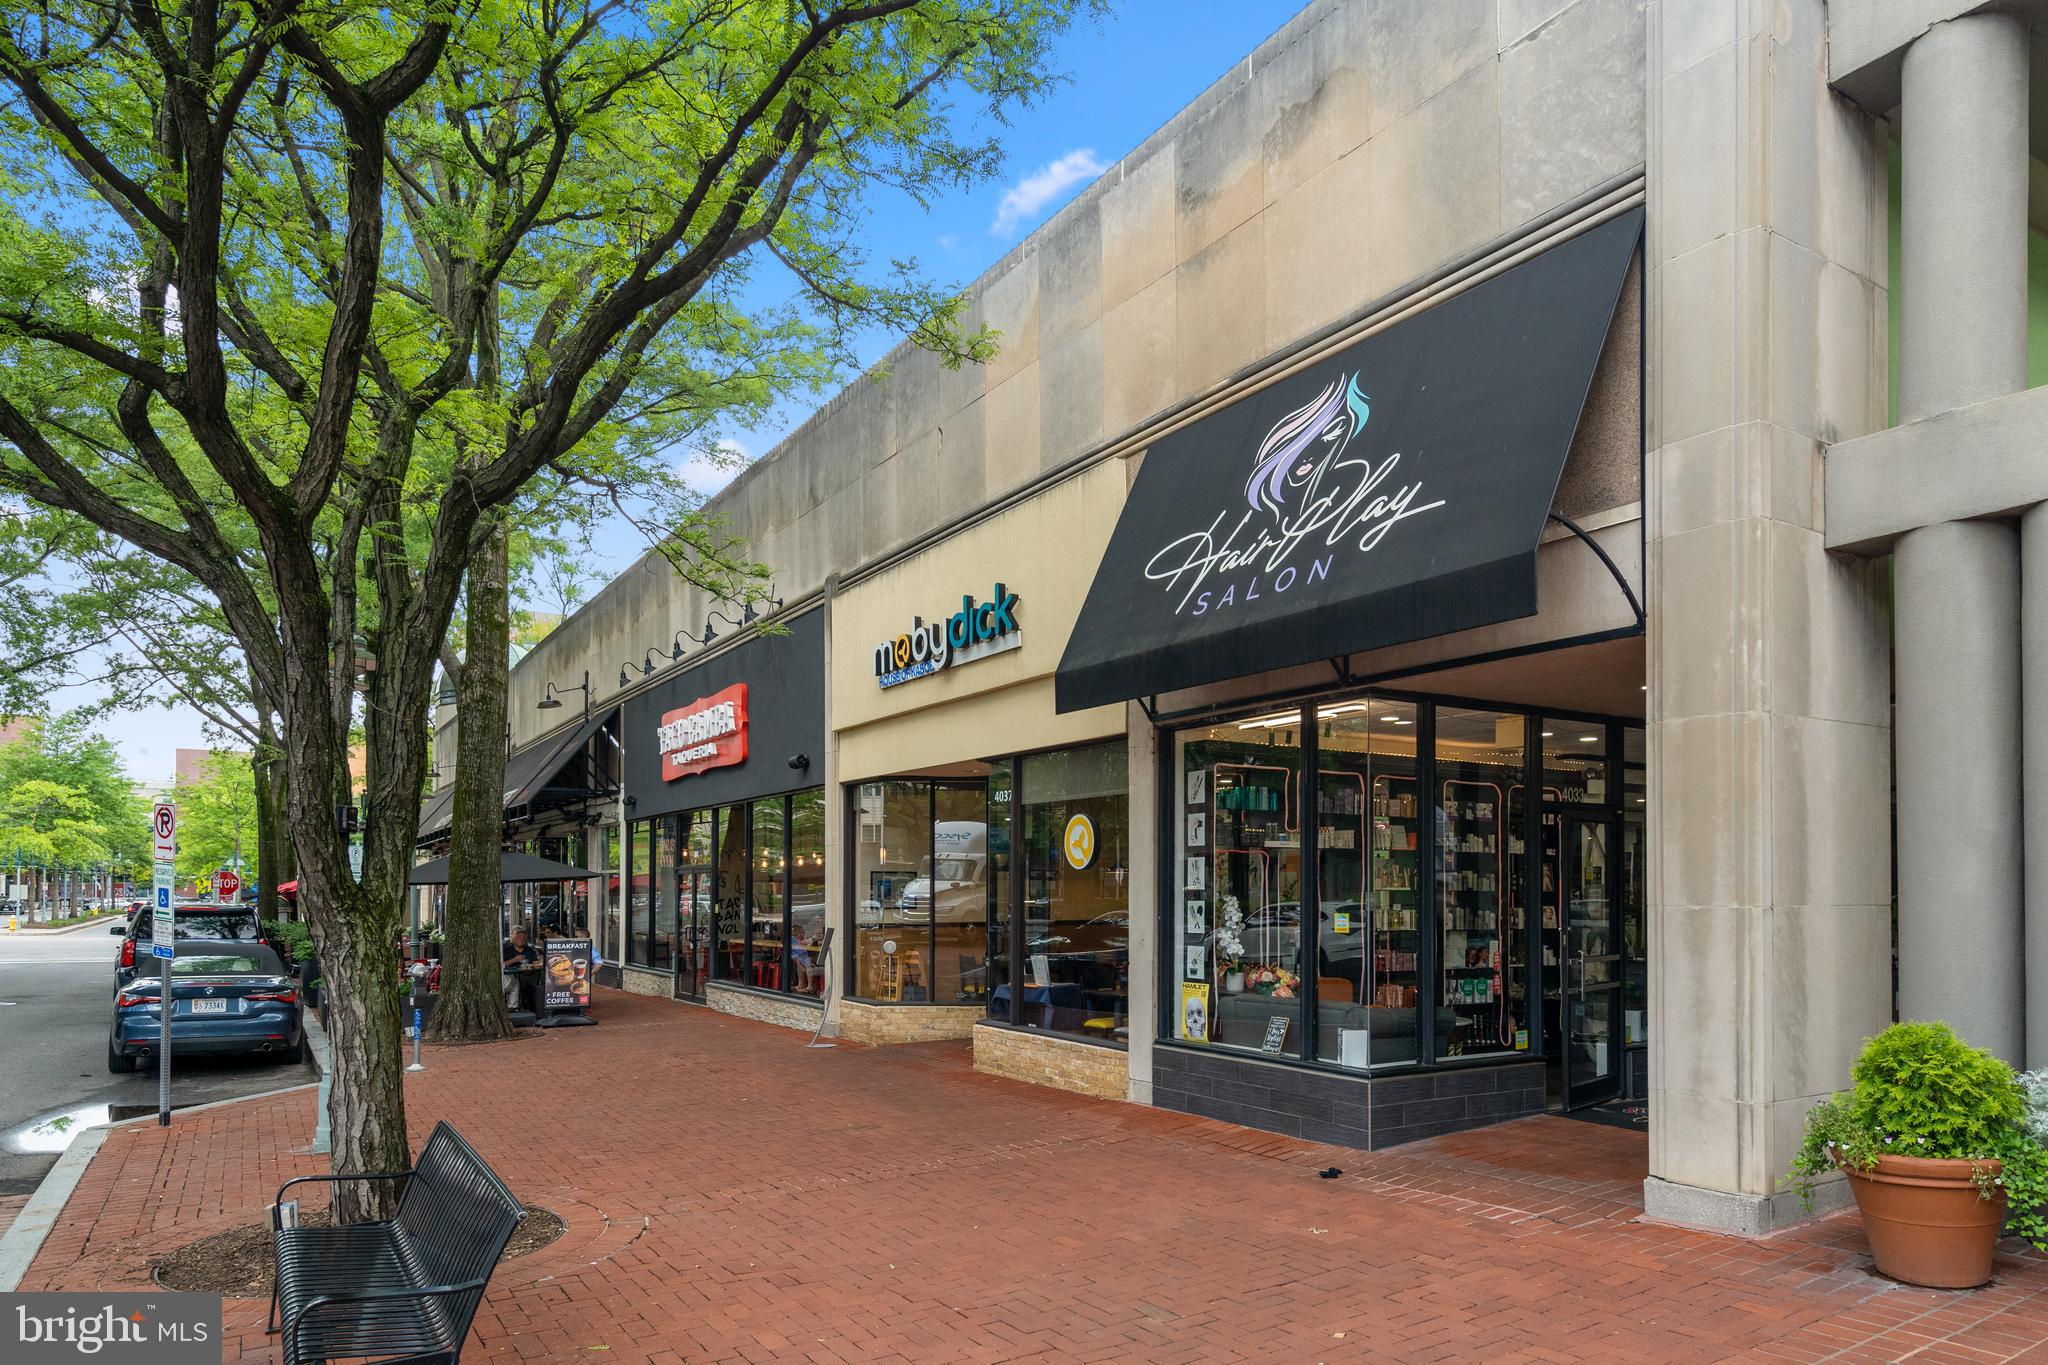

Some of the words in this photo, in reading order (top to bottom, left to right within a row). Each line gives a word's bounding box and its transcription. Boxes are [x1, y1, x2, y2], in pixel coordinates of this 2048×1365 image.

[1145, 509, 1283, 614] Hair
[1266, 453, 1446, 572] Play
[1192, 554, 1334, 616] SALON
[671, 743, 718, 765] TAQUERIA
[994, 790, 1012, 802] 4037
[1562, 787, 1584, 802] 4033
[219, 879, 238, 889] TOP
[1182, 983, 1206, 991] HAMLET
